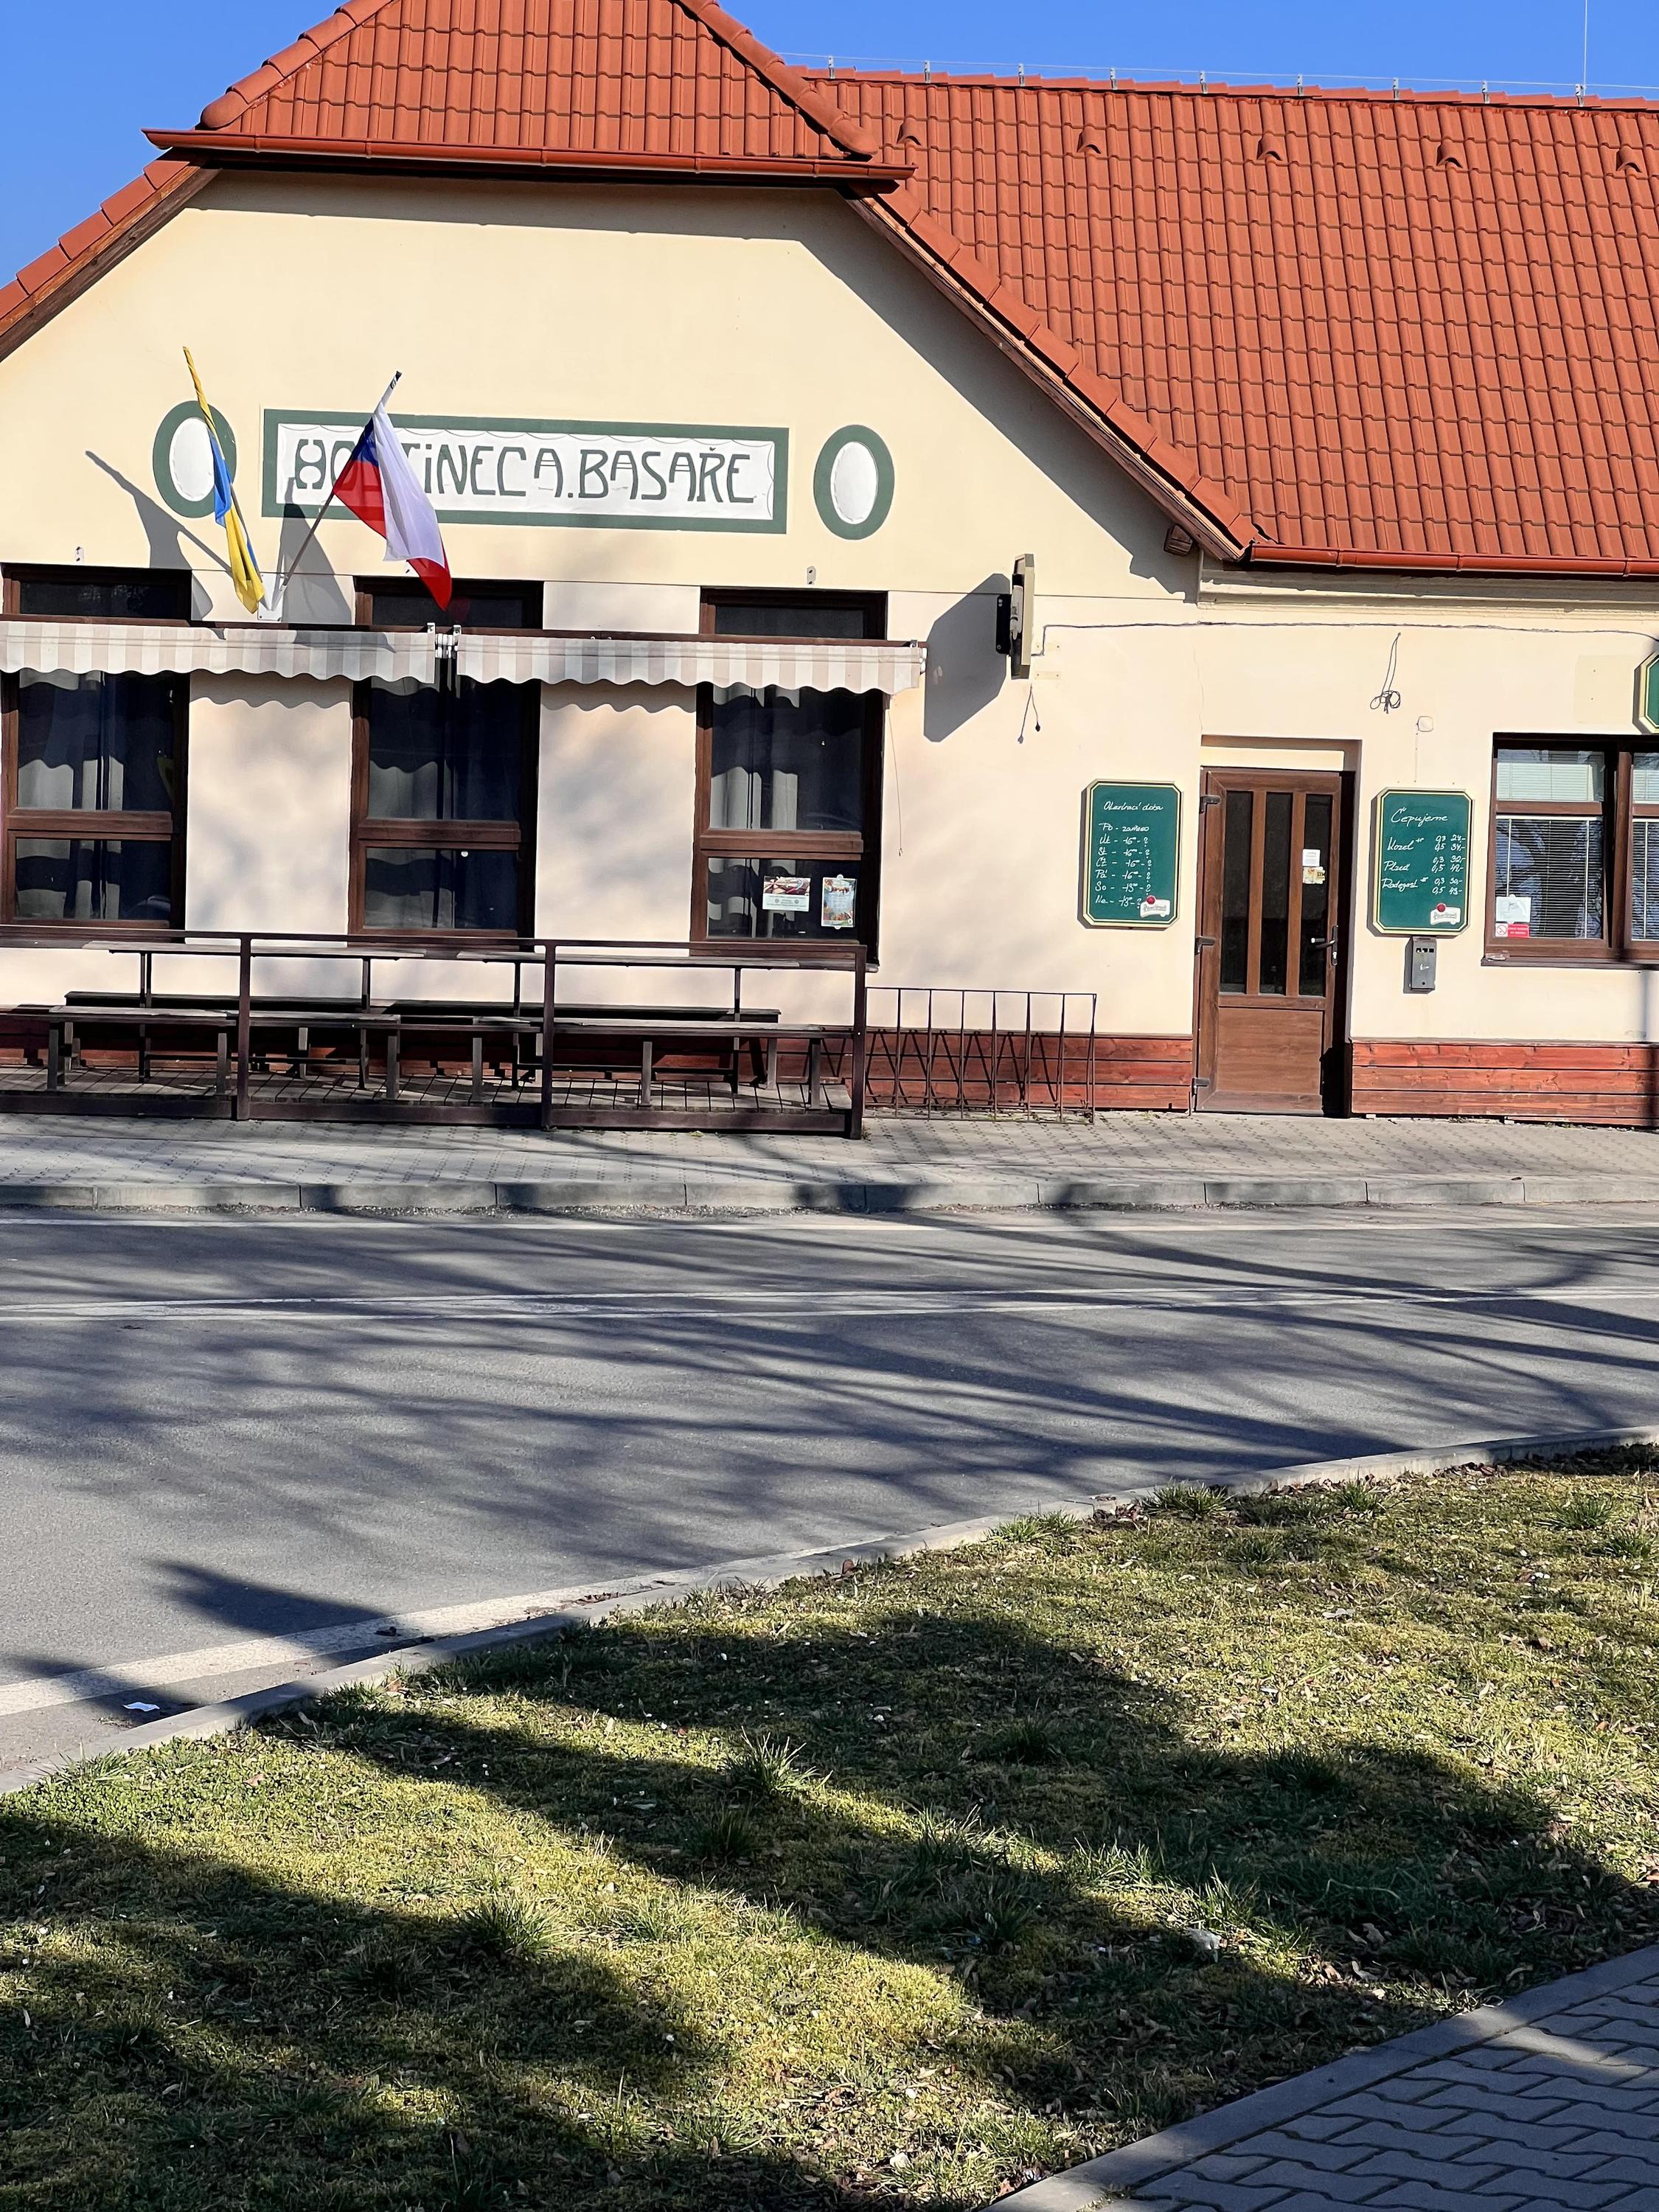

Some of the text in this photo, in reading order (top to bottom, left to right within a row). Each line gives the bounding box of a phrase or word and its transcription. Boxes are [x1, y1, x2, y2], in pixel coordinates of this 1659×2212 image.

[296, 439, 526, 496] HOiNEC
[1391, 807, 1448, 827] Čepujeme
[1099, 822, 1113, 831] Po
[1387, 836, 1414, 851] Kozel
[1095, 880, 1107, 891] So
